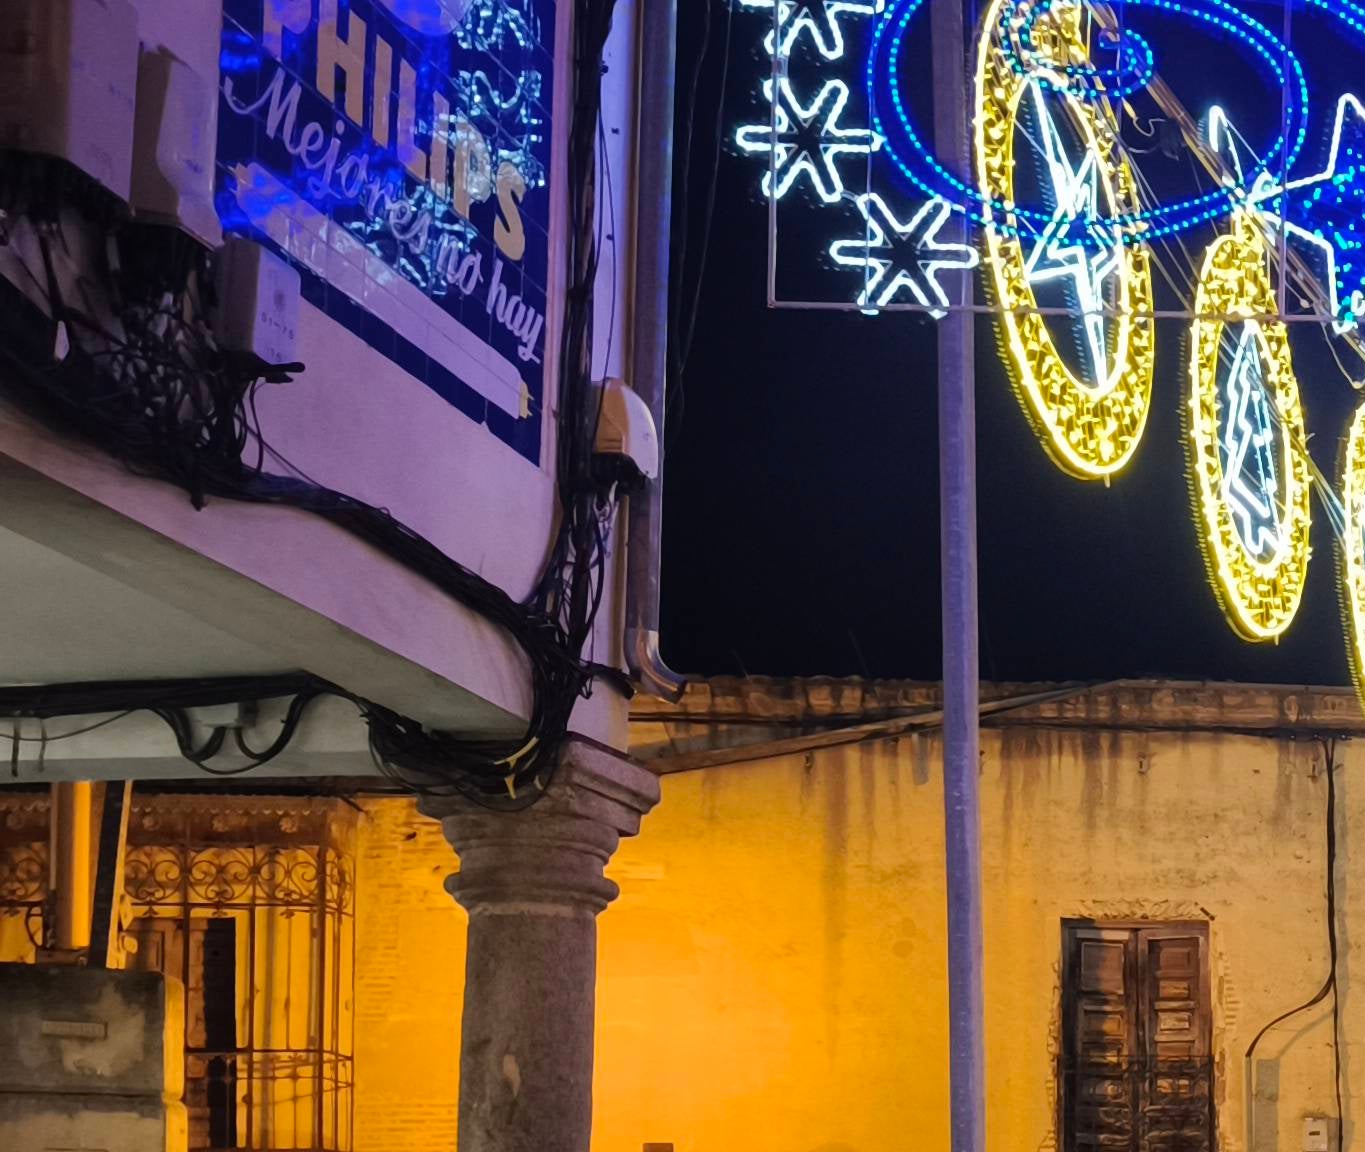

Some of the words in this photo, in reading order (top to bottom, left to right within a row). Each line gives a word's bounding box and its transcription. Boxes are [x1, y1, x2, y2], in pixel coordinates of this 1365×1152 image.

[224, 67, 432, 253] Mejores
[436, 231, 483, 295] no
[486, 259, 544, 364] hay
